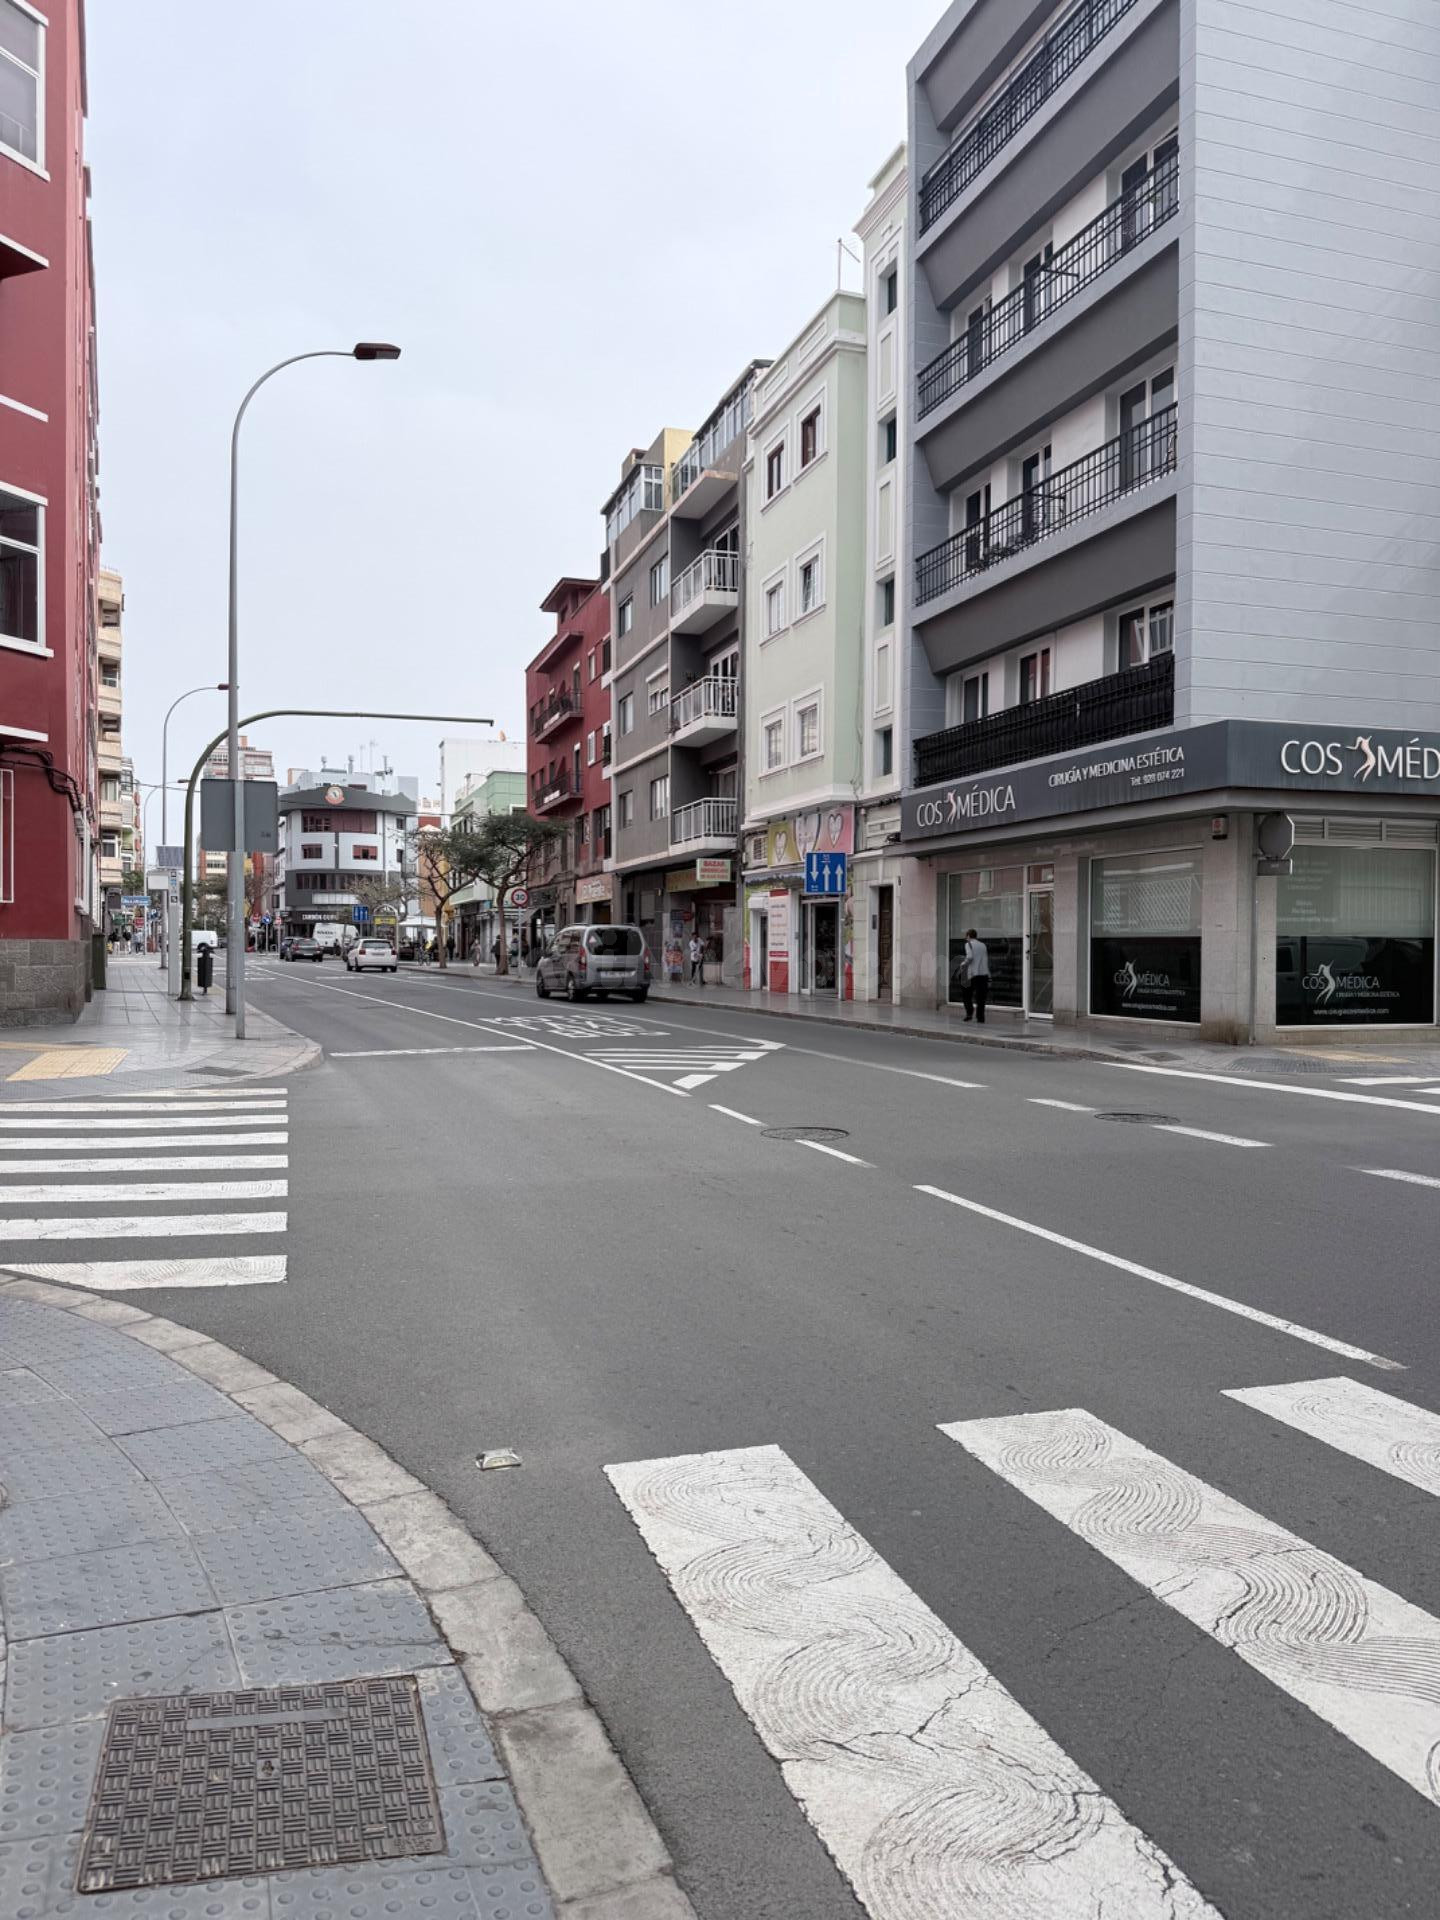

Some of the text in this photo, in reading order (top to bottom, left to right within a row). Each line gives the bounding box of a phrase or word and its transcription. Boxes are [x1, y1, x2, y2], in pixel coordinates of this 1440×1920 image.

[1048, 746, 1185, 787] CIRUGÍA Y MEDICINA ESTÉTICA
[1281, 740, 1343, 776] COS
[1171, 768, 1185, 780] 221
[916, 784, 1016, 827] COS MÉDICA
[1137, 970, 1170, 987] MÉDICA
[1302, 973, 1380, 990] COS MÉDICA
